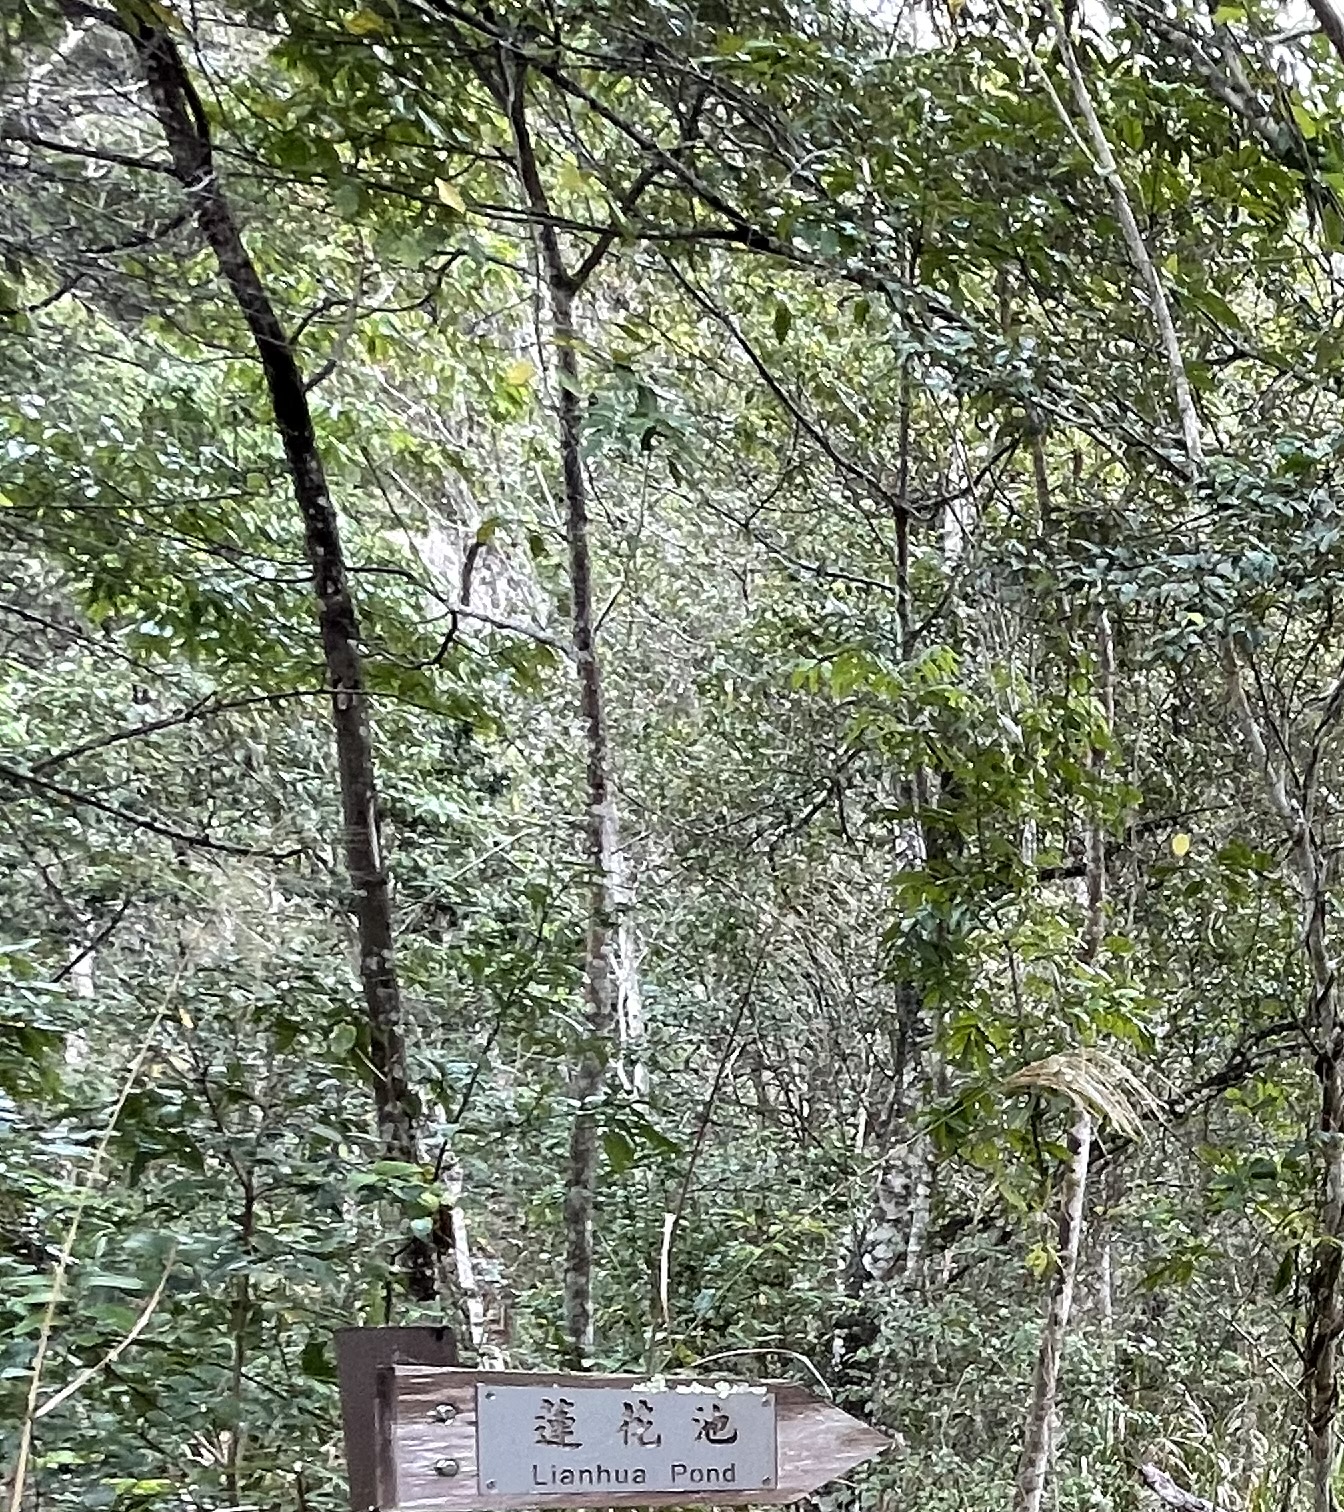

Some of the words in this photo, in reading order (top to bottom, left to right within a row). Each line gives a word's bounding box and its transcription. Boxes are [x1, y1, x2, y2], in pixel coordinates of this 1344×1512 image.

[534, 1398, 739, 1448] 蓮花池
[532, 1464, 647, 1486] Lianhua
[671, 1462, 737, 1484] Pond
